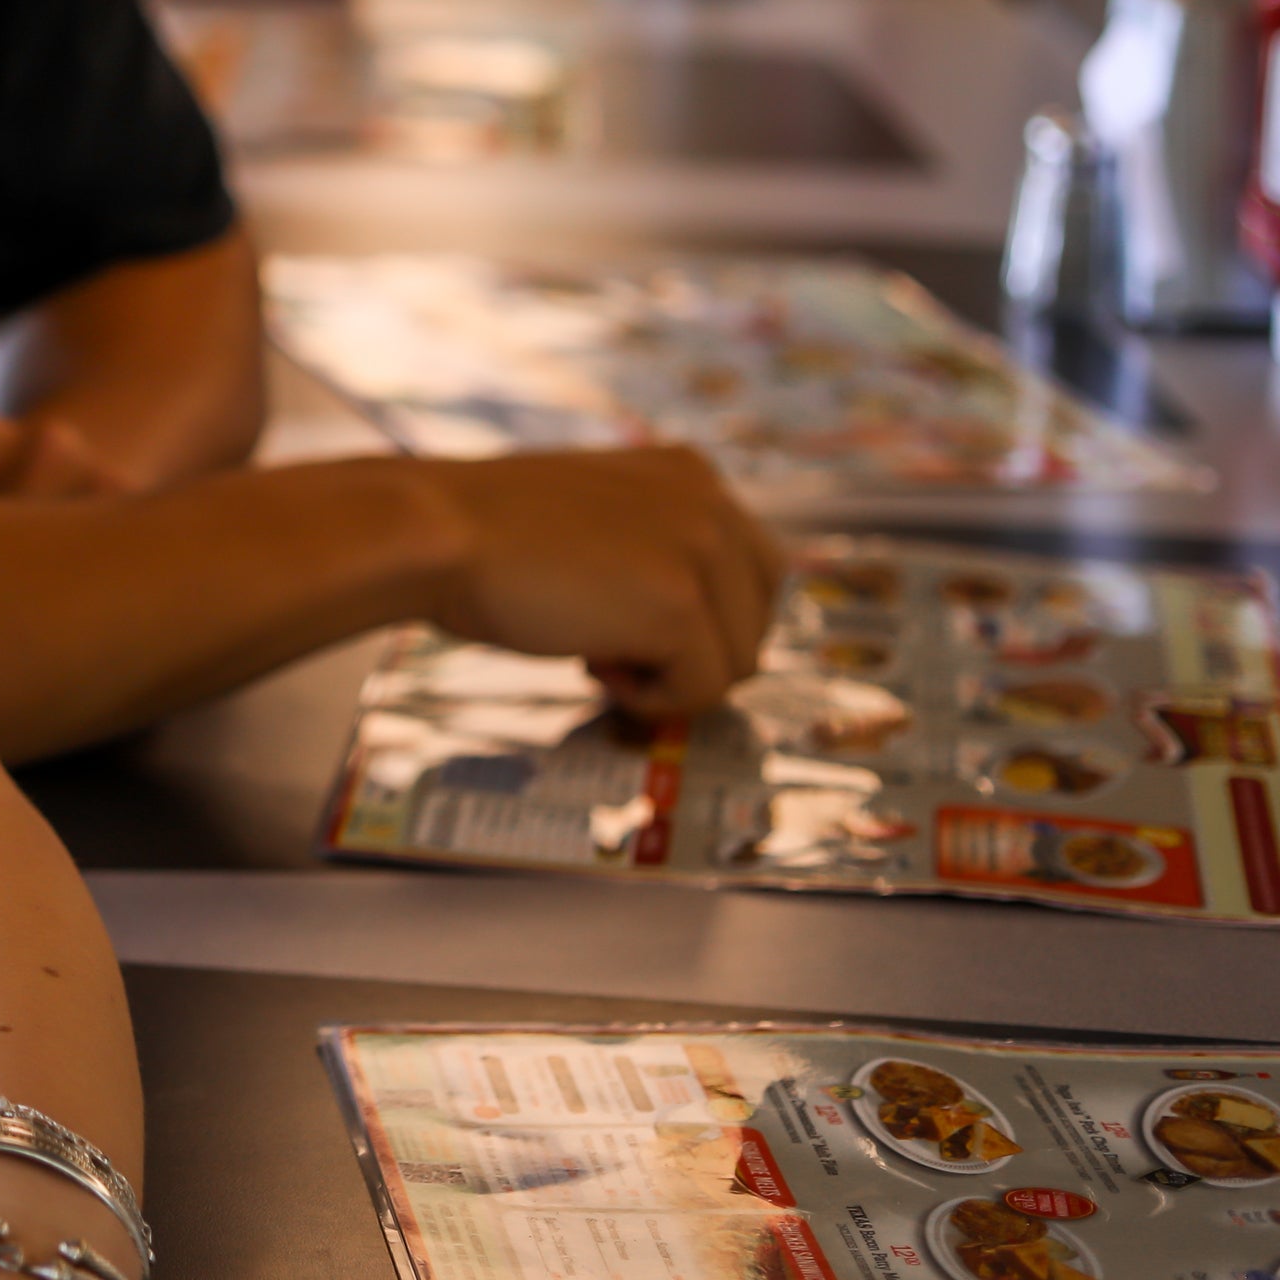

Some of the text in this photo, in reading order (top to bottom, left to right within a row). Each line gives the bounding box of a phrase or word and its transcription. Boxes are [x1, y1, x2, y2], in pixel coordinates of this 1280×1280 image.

[845, 1205, 873, 1230] TEXAS
[859, 1230, 880, 1252] Bacon
[871, 1253, 892, 1271] Patty
